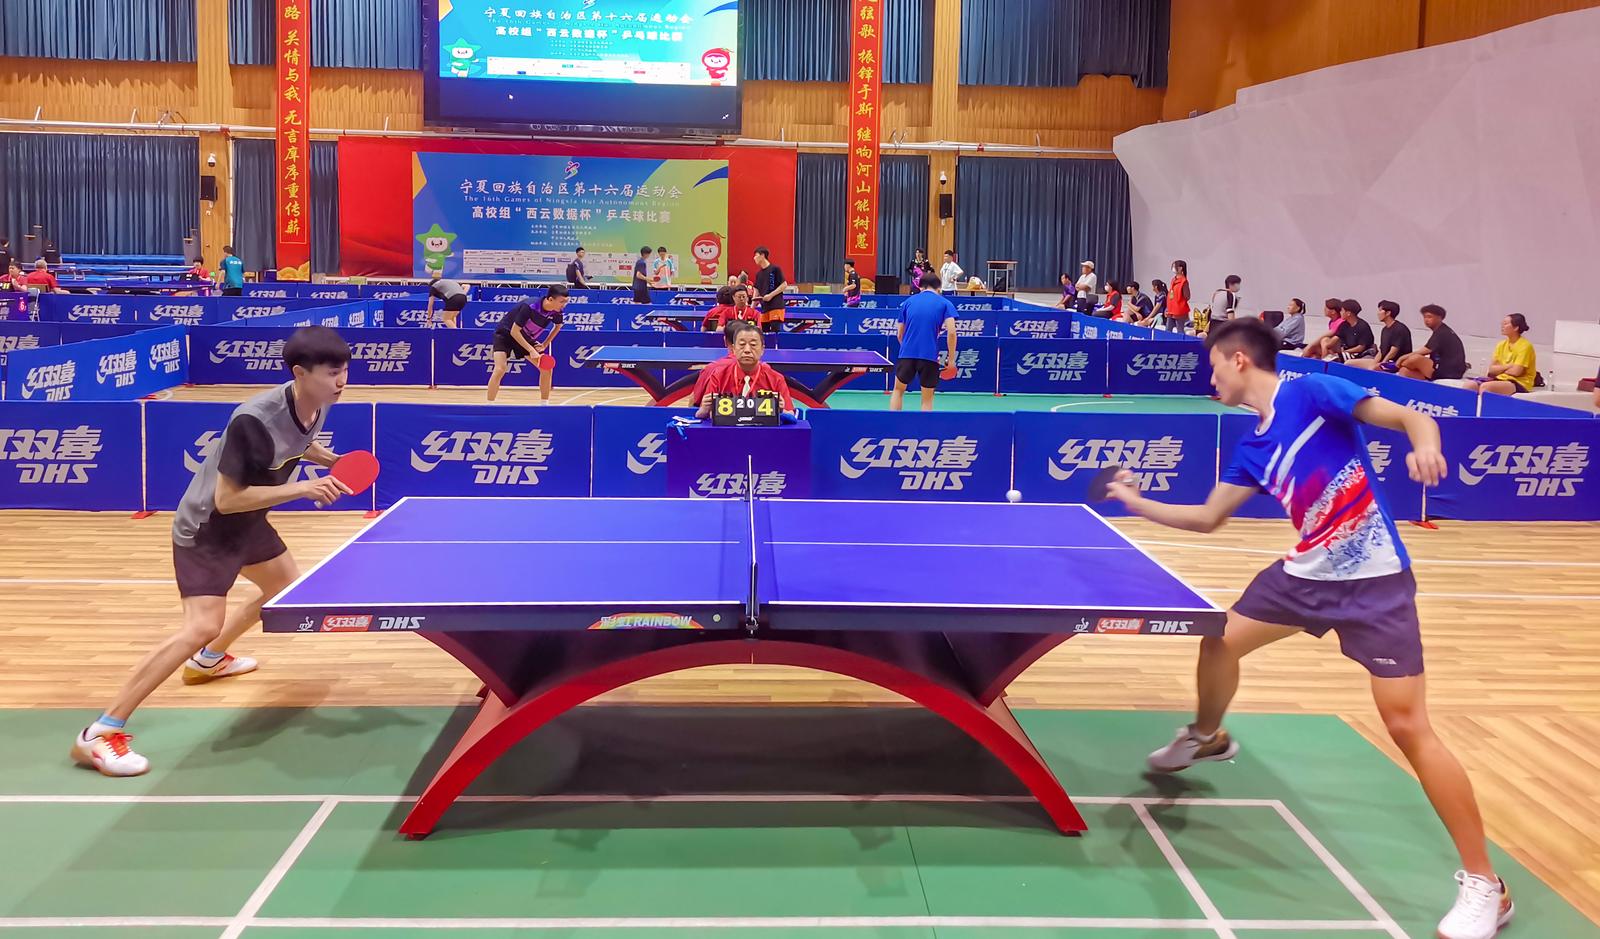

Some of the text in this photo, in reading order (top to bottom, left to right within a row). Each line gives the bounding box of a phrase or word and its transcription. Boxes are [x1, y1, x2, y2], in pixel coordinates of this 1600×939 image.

[460, 179, 683, 198] 宁夏回族自治区第十六届运动会
[68, 304, 121, 321] 红双喜
[150, 304, 204, 321] 红双喜
[1010, 320, 1059, 335] 红双喜
[96, 349, 137, 384] 红双喜
[368, 361, 408, 372] DHS
[1017, 351, 1088, 375] 红双喜
[1127, 352, 1199, 376] 红双喜
[22, 360, 76, 399] 红双喜
[115, 371, 136, 388] DHS
[1048, 370, 1086, 381] DHS
[1157, 371, 1196, 381] DHS
[45, 385, 74, 401] DHS
[718, 398, 773, 416] 8 2 0 4
[411, 429, 554, 473] 红双喜
[840, 436, 978, 478] 红双喜
[1049, 436, 1184, 480] 红双喜
[1459, 442, 1589, 486] 红双喜
[16, 464, 98, 483] DHS
[472, 465, 548, 485] DHS
[899, 471, 972, 490] DHS
[1134, 473, 1178, 491] HS
[689, 471, 786, 498] 红双喜
[1515, 478, 1583, 496] DHS
[323, 616, 369, 631] 红双喜
[378, 617, 425, 629] DHS
[632, 616, 692, 627] RAINBOW
[1098, 619, 1141, 632] 红双喜
[1149, 621, 1194, 633] DHS
